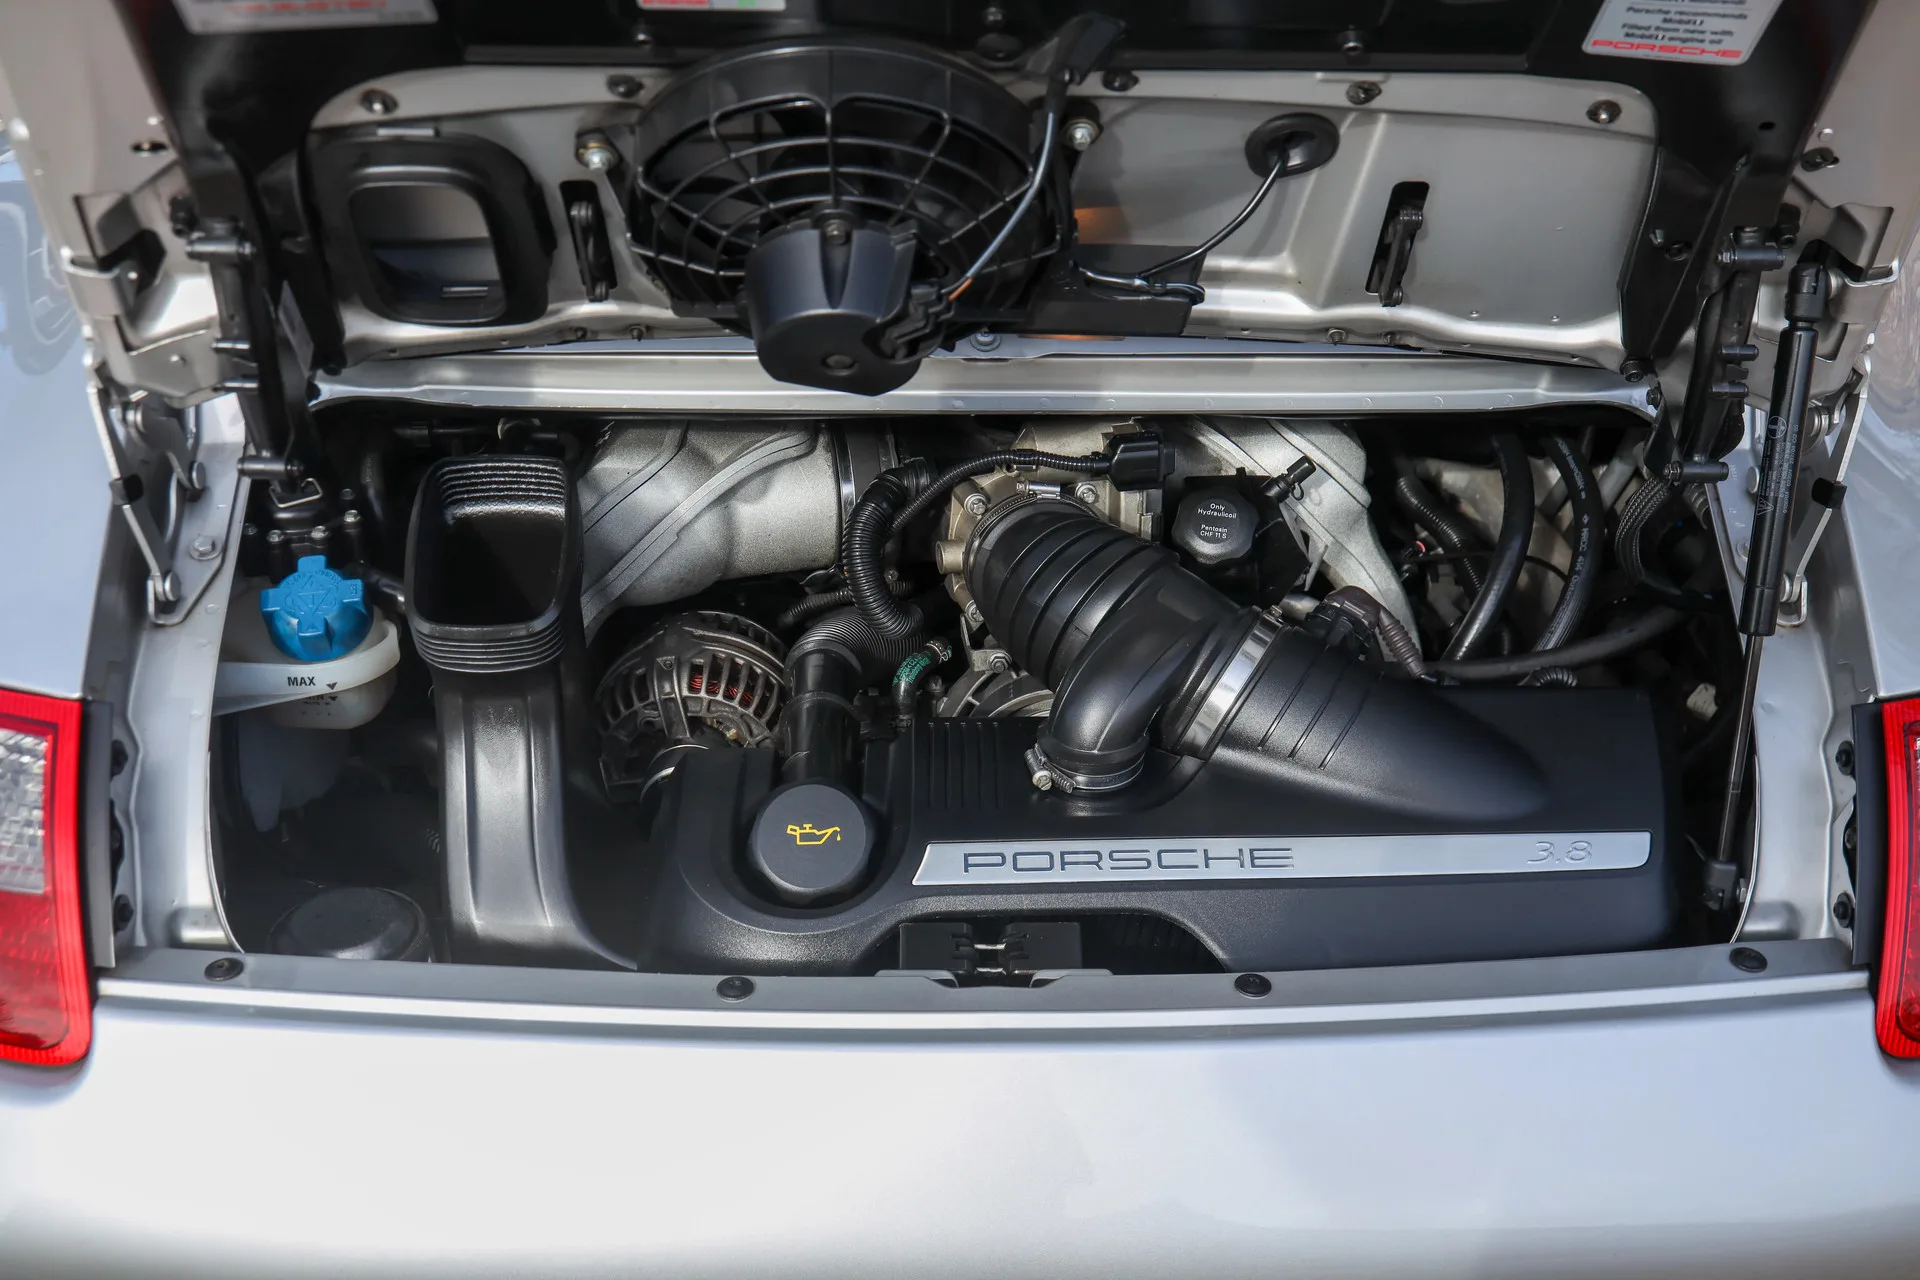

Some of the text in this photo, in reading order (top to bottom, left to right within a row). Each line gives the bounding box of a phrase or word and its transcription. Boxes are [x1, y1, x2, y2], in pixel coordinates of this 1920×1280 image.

[1592, 39, 1743, 59] PORSCHE
[1210, 503, 1226, 511] Only
[1197, 508, 1237, 519] Hydraulicoil
[1201, 524, 1228, 533] Pentosin
[287, 676, 316, 686] MAX
[1527, 840, 1592, 864] 3.8
[962, 847, 1294, 874] PORSCHE
